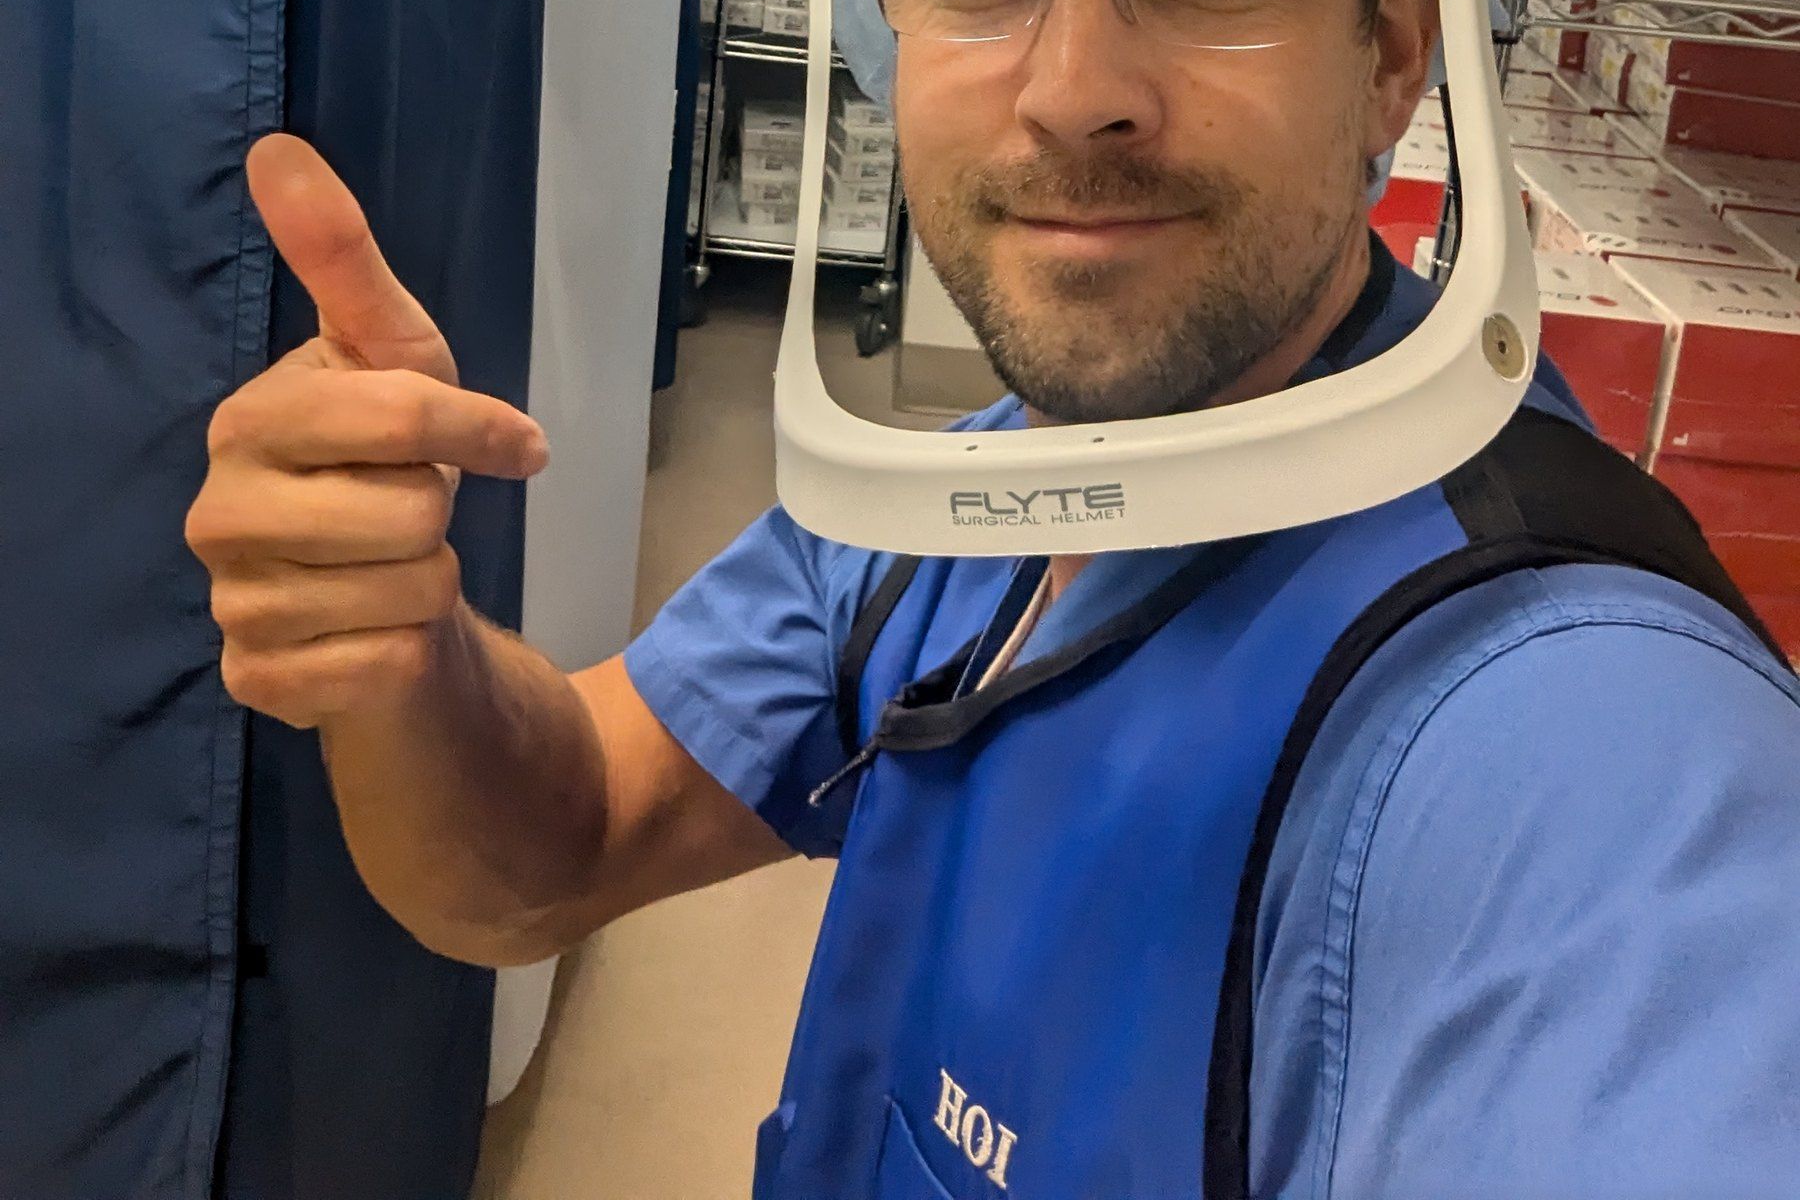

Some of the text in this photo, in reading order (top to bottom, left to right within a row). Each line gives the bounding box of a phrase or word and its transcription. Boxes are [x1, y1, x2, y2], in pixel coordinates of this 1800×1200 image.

[950, 483, 1125, 515] FLYTE
[952, 508, 1126, 526] SURGICAL HELMET
[934, 1068, 1018, 1190] HOI
